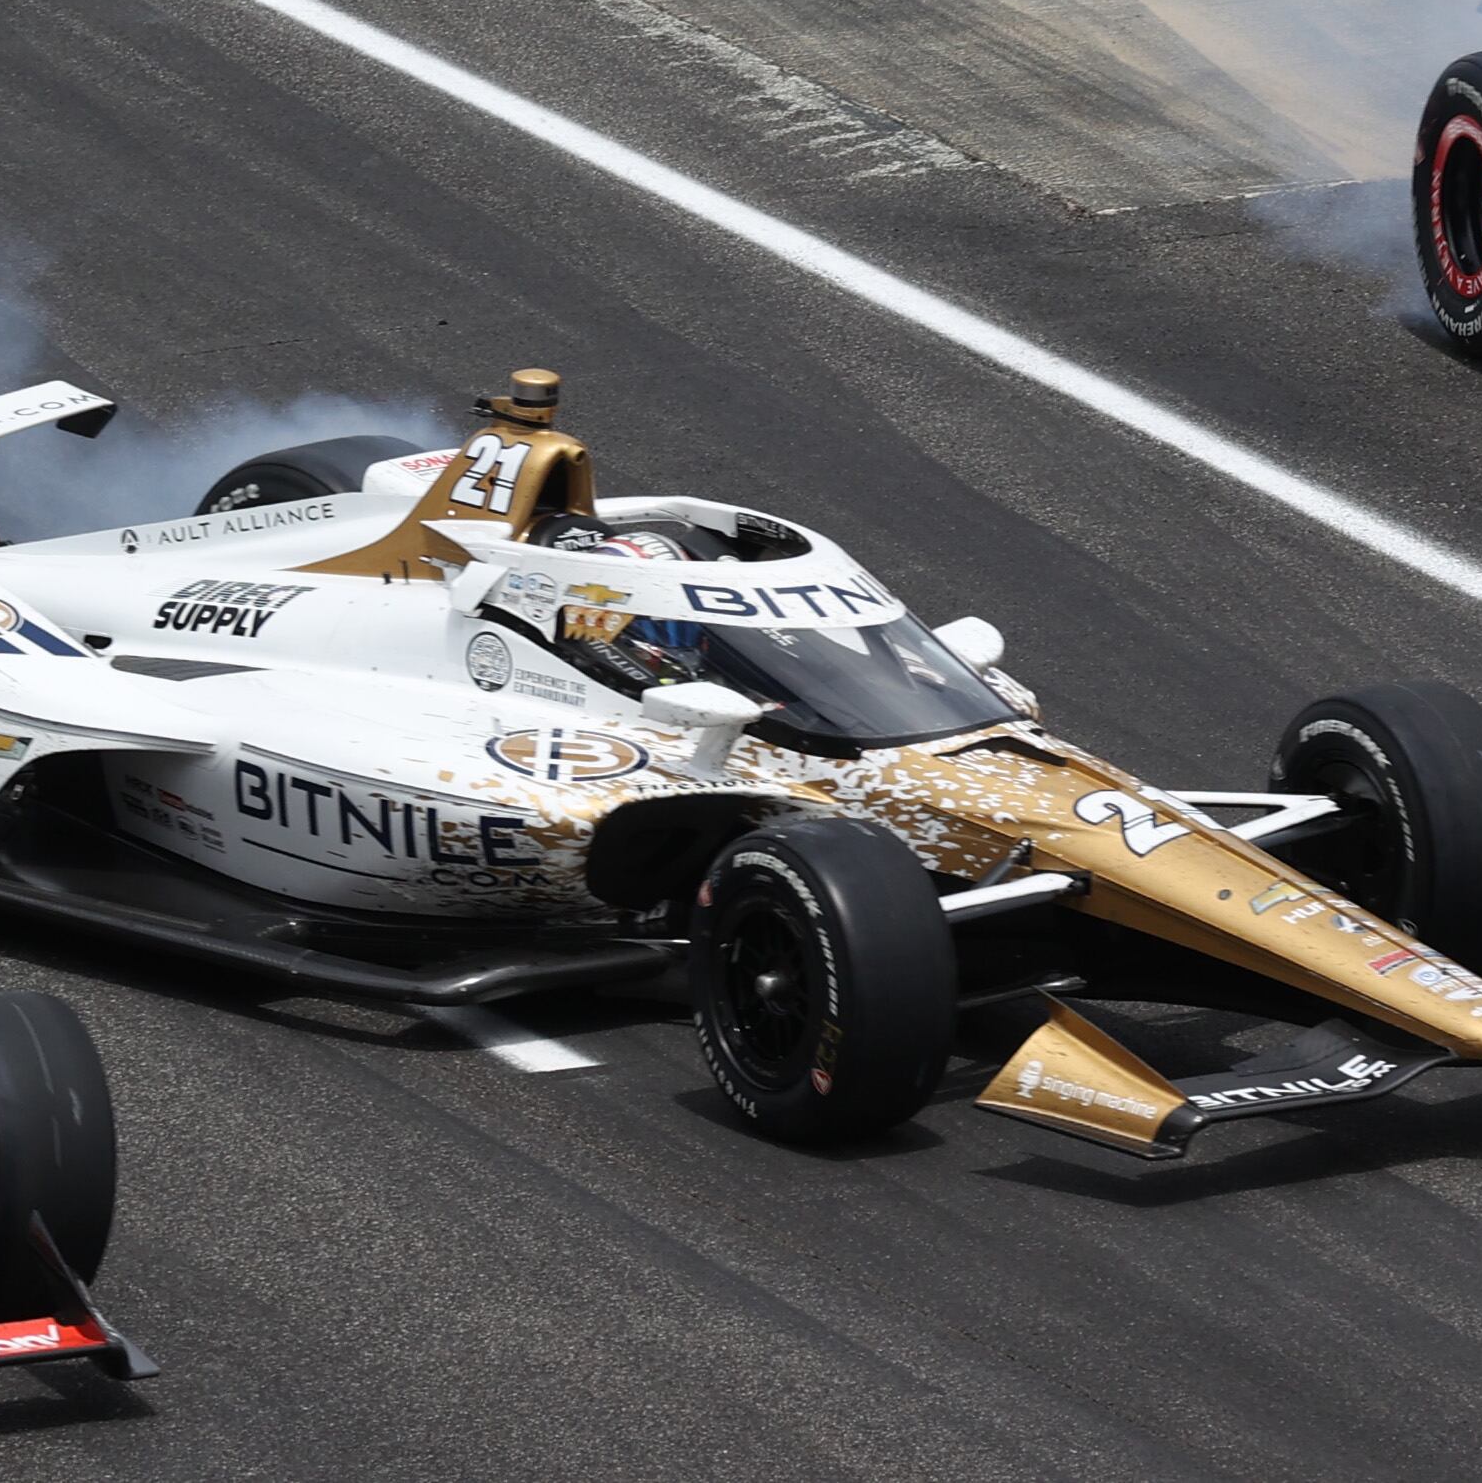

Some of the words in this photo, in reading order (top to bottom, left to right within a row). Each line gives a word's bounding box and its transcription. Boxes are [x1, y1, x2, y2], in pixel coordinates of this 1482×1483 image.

[400, 453, 456, 472] SONA
[449, 432, 533, 517] 21
[157, 521, 213, 547] AULT
[222, 502, 337, 535] ALLIANCE
[169, 578, 320, 610] DIRECT
[152, 600, 278, 638] SUPPLY
[513, 682, 588, 709] EXTRAORDINARY
[514, 668, 570, 694] EXPERIENCE
[570, 681, 587, 696] THE
[636, 777, 773, 795] Firestone
[234, 758, 541, 867] BITNILE
[1040, 1074, 1095, 1107] singing
[1094, 1089, 1159, 1120] machine
[1188, 1054, 1381, 1109] BITNILE
